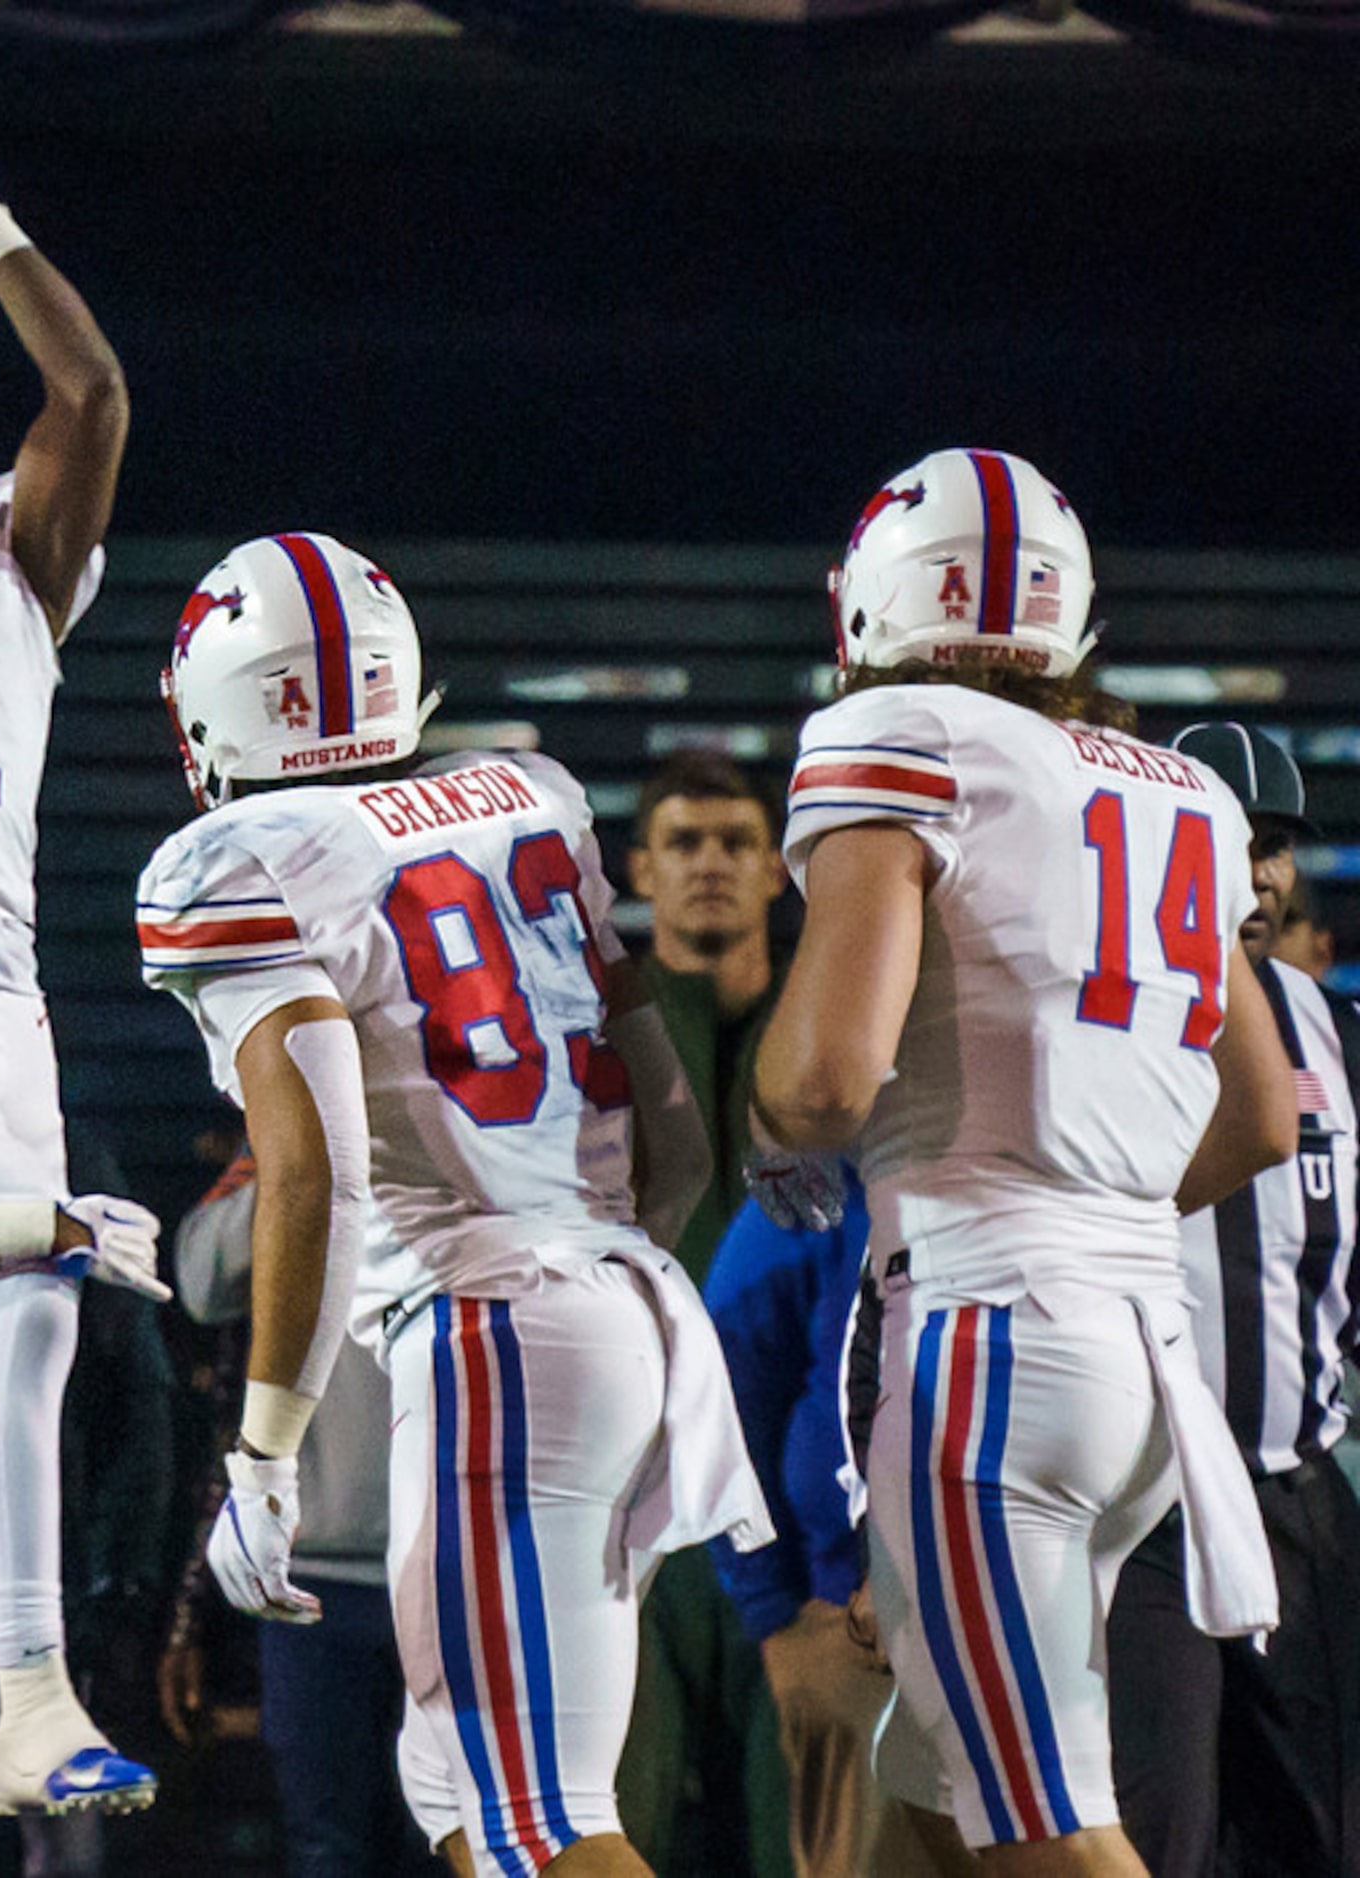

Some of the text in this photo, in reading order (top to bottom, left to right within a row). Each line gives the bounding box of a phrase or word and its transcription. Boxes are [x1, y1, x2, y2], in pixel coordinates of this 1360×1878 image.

[280, 738, 397, 770] MUSTANGS
[358, 765, 539, 837] GRANSON
[1076, 788, 1227, 1053] 14
[382, 829, 633, 1127] 83
[1300, 1154, 1332, 1199] U
